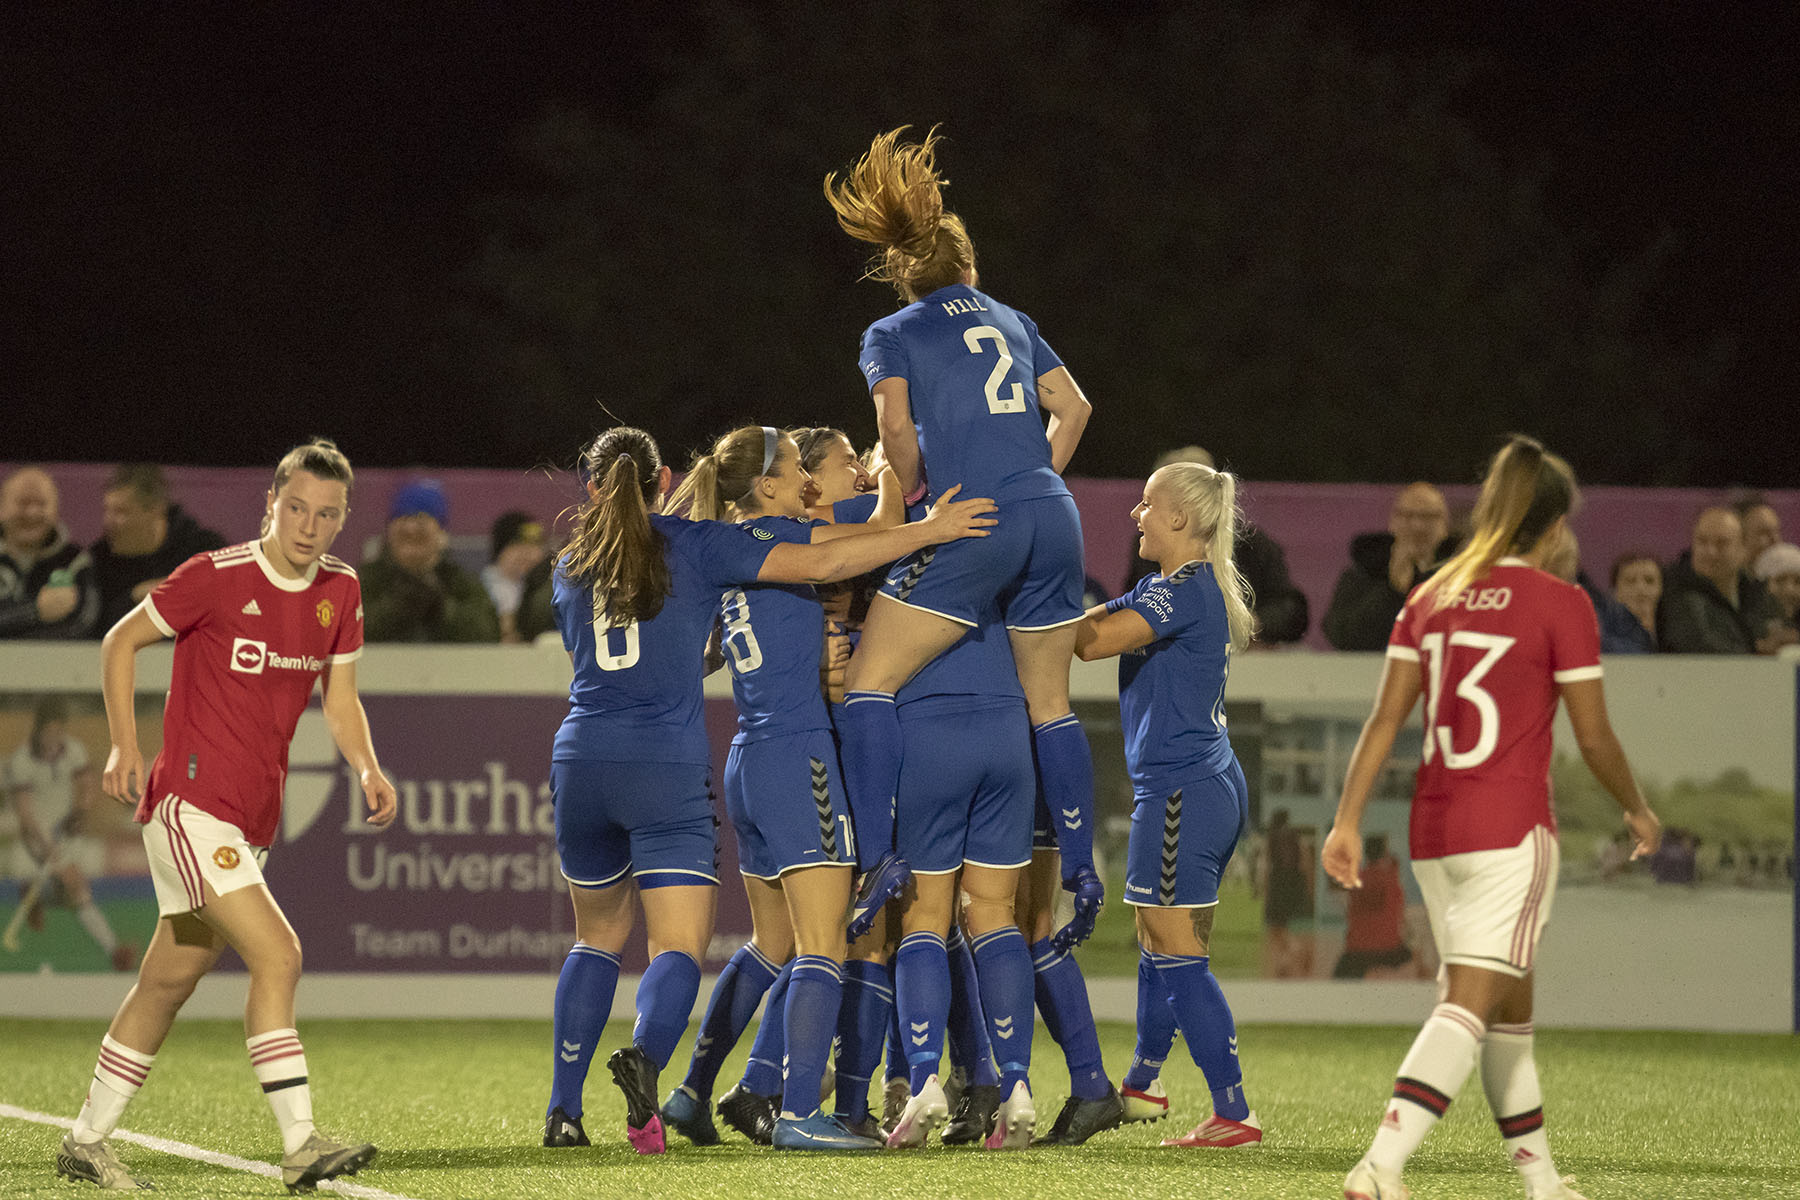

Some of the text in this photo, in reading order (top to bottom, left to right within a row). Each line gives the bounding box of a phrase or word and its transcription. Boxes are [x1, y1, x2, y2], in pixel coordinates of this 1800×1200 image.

[941, 296, 988, 317] HILL
[963, 325, 1027, 415] 2
[1147, 586, 1174, 600] ustic
[592, 578, 641, 672] 6
[267, 650, 325, 673] TeamVie
[1420, 629, 1517, 770] 13
[342, 761, 557, 836] Durha
[347, 842, 568, 893] Universit
[352, 923, 441, 958] Team
